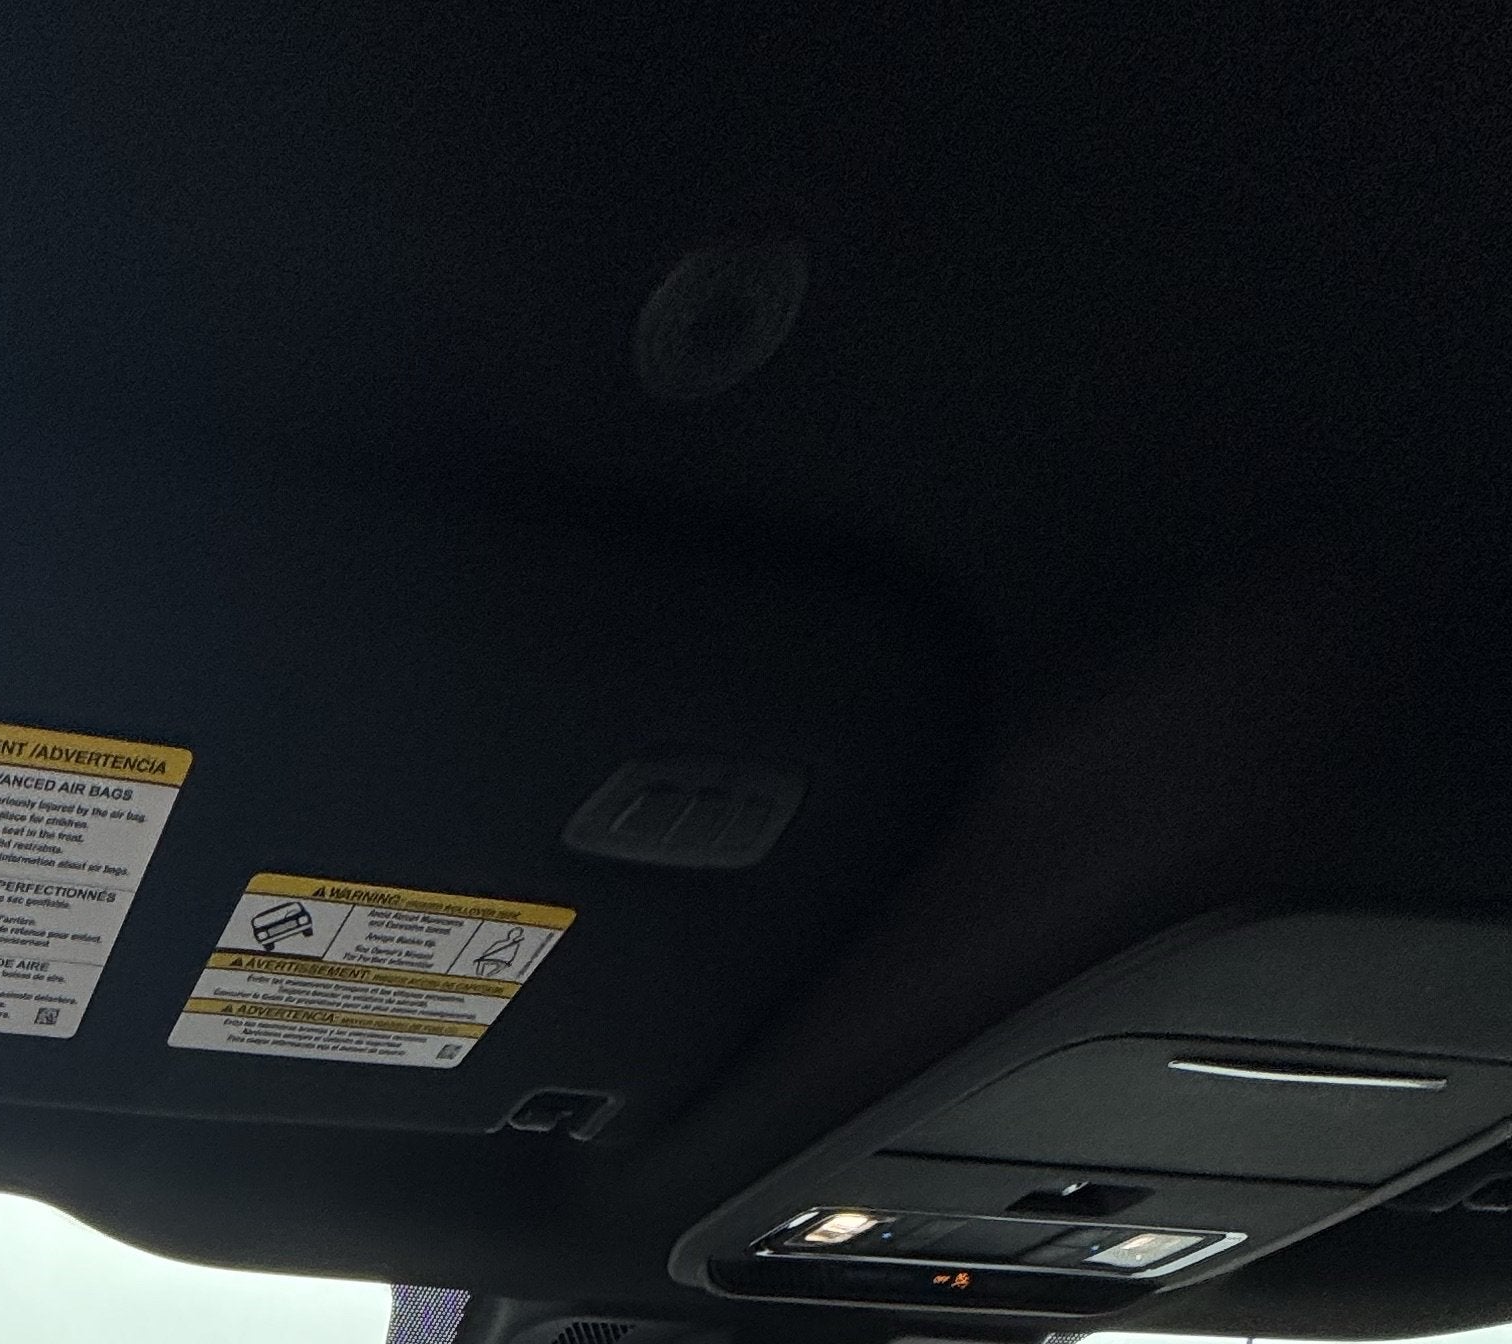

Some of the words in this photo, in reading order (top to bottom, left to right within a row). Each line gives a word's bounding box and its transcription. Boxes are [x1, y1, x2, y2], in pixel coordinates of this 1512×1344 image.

[57, 780, 86, 795] AIR
[87, 784, 134, 801] BAGS
[15, 960, 49, 972] AIRE
